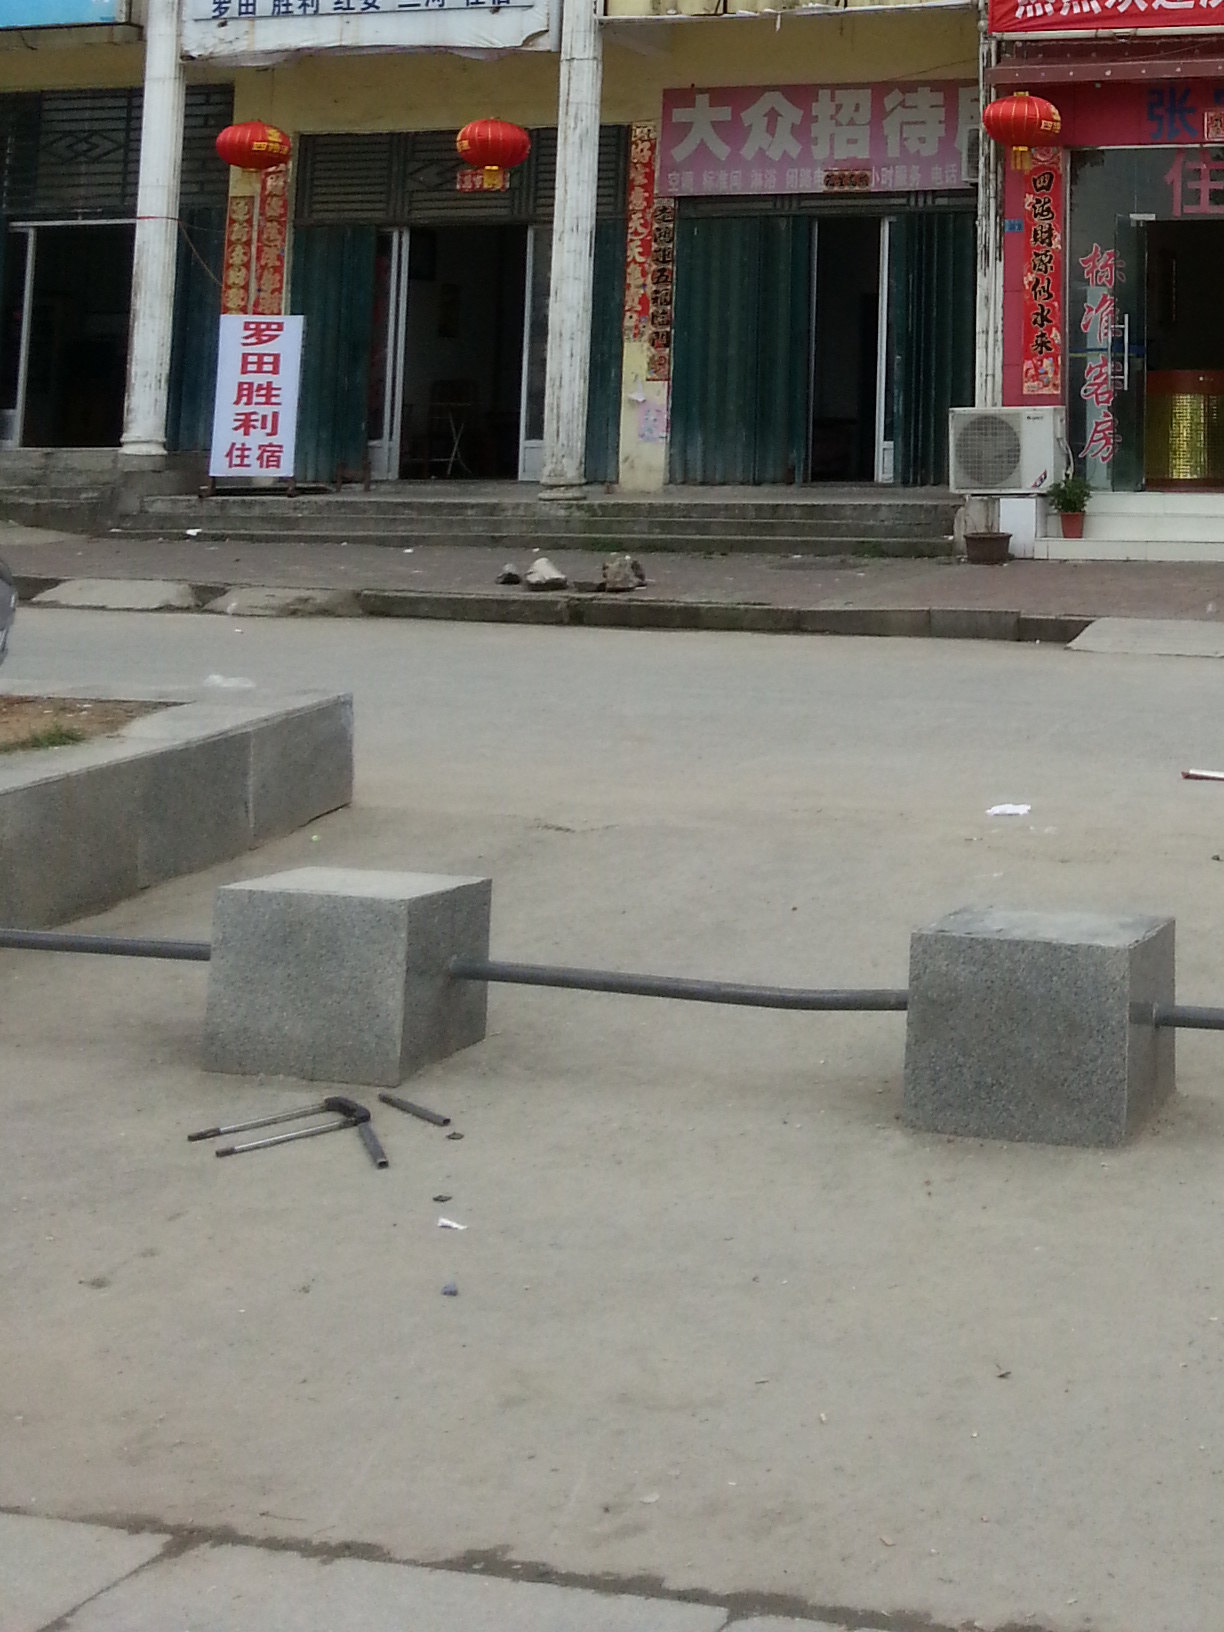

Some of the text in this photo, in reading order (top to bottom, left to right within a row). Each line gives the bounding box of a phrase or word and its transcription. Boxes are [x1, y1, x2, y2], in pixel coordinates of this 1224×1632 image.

[232, 320, 285, 438] 罗田胜利
[225, 442, 284, 470] 住宿
